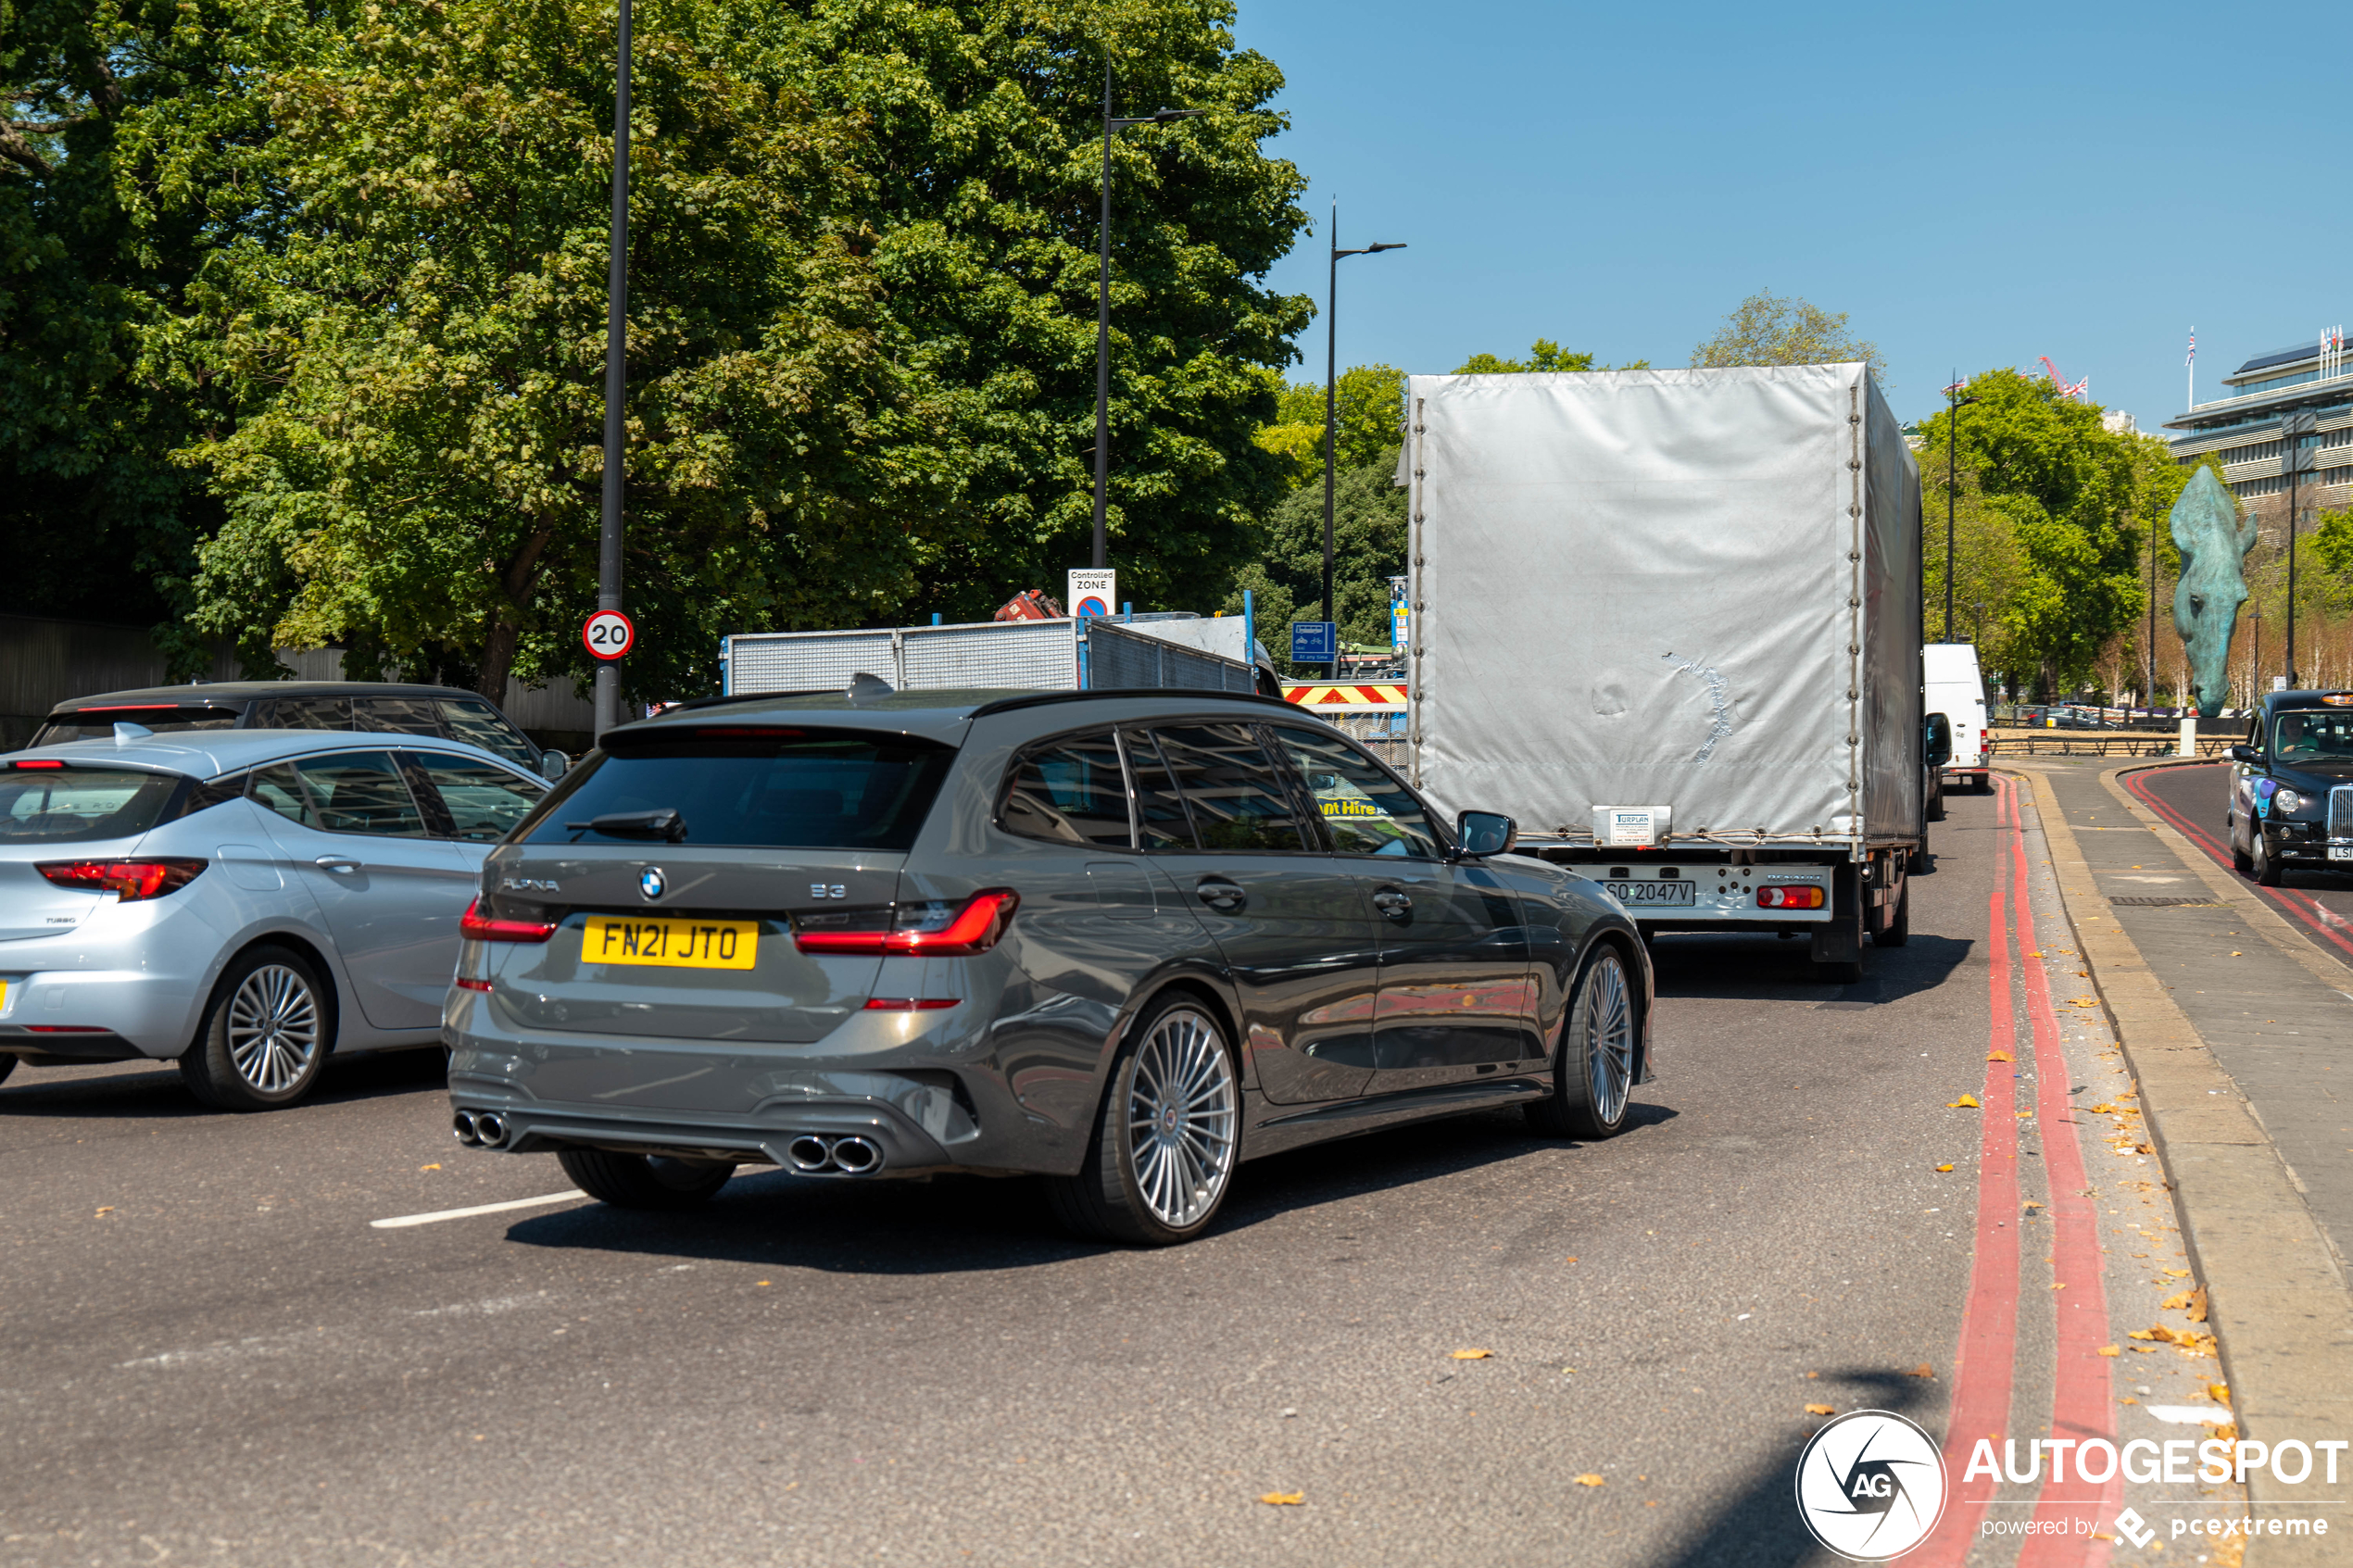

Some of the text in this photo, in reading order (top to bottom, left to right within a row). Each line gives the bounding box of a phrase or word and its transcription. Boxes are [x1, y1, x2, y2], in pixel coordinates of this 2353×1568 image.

[1076, 581, 1107, 589] ZONE
[592, 623, 626, 645] 20
[1342, 801, 1376, 815] Hire
[1768, 874, 1822, 883] RENAULT
[1635, 884, 1689, 900] 2047V
[603, 922, 737, 960] FN21 JTO
